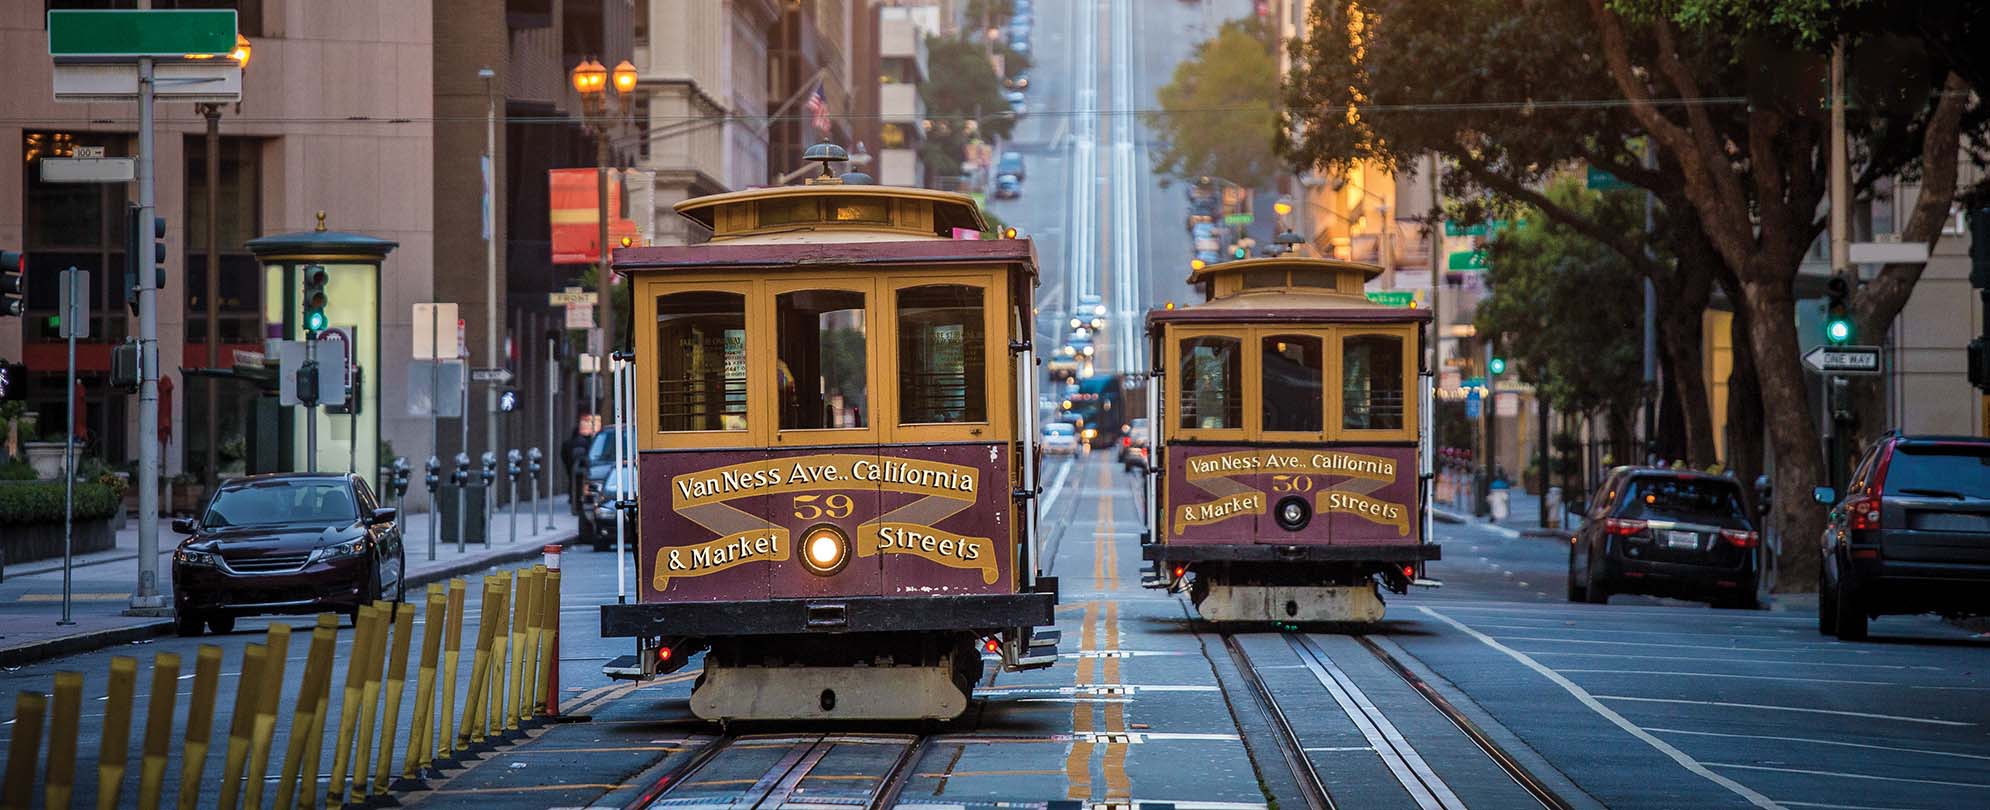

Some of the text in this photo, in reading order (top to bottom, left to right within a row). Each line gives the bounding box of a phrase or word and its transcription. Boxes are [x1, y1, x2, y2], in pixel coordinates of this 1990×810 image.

[1824, 353, 1873, 363] ONE WAY
[1191, 458, 1219, 474] Van
[1220, 455, 1261, 471] Ness
[1311, 454, 1394, 476] California
[677, 477, 720, 501] Van
[721, 469, 782, 494] Ness
[851, 459, 975, 492] California
[1272, 475, 1313, 493] 50
[793, 494, 854, 520] 59
[1184, 495, 1260, 521] & Market
[1329, 493, 1400, 520] Streets
[667, 533, 779, 571] & Market
[877, 526, 981, 561] Streets
